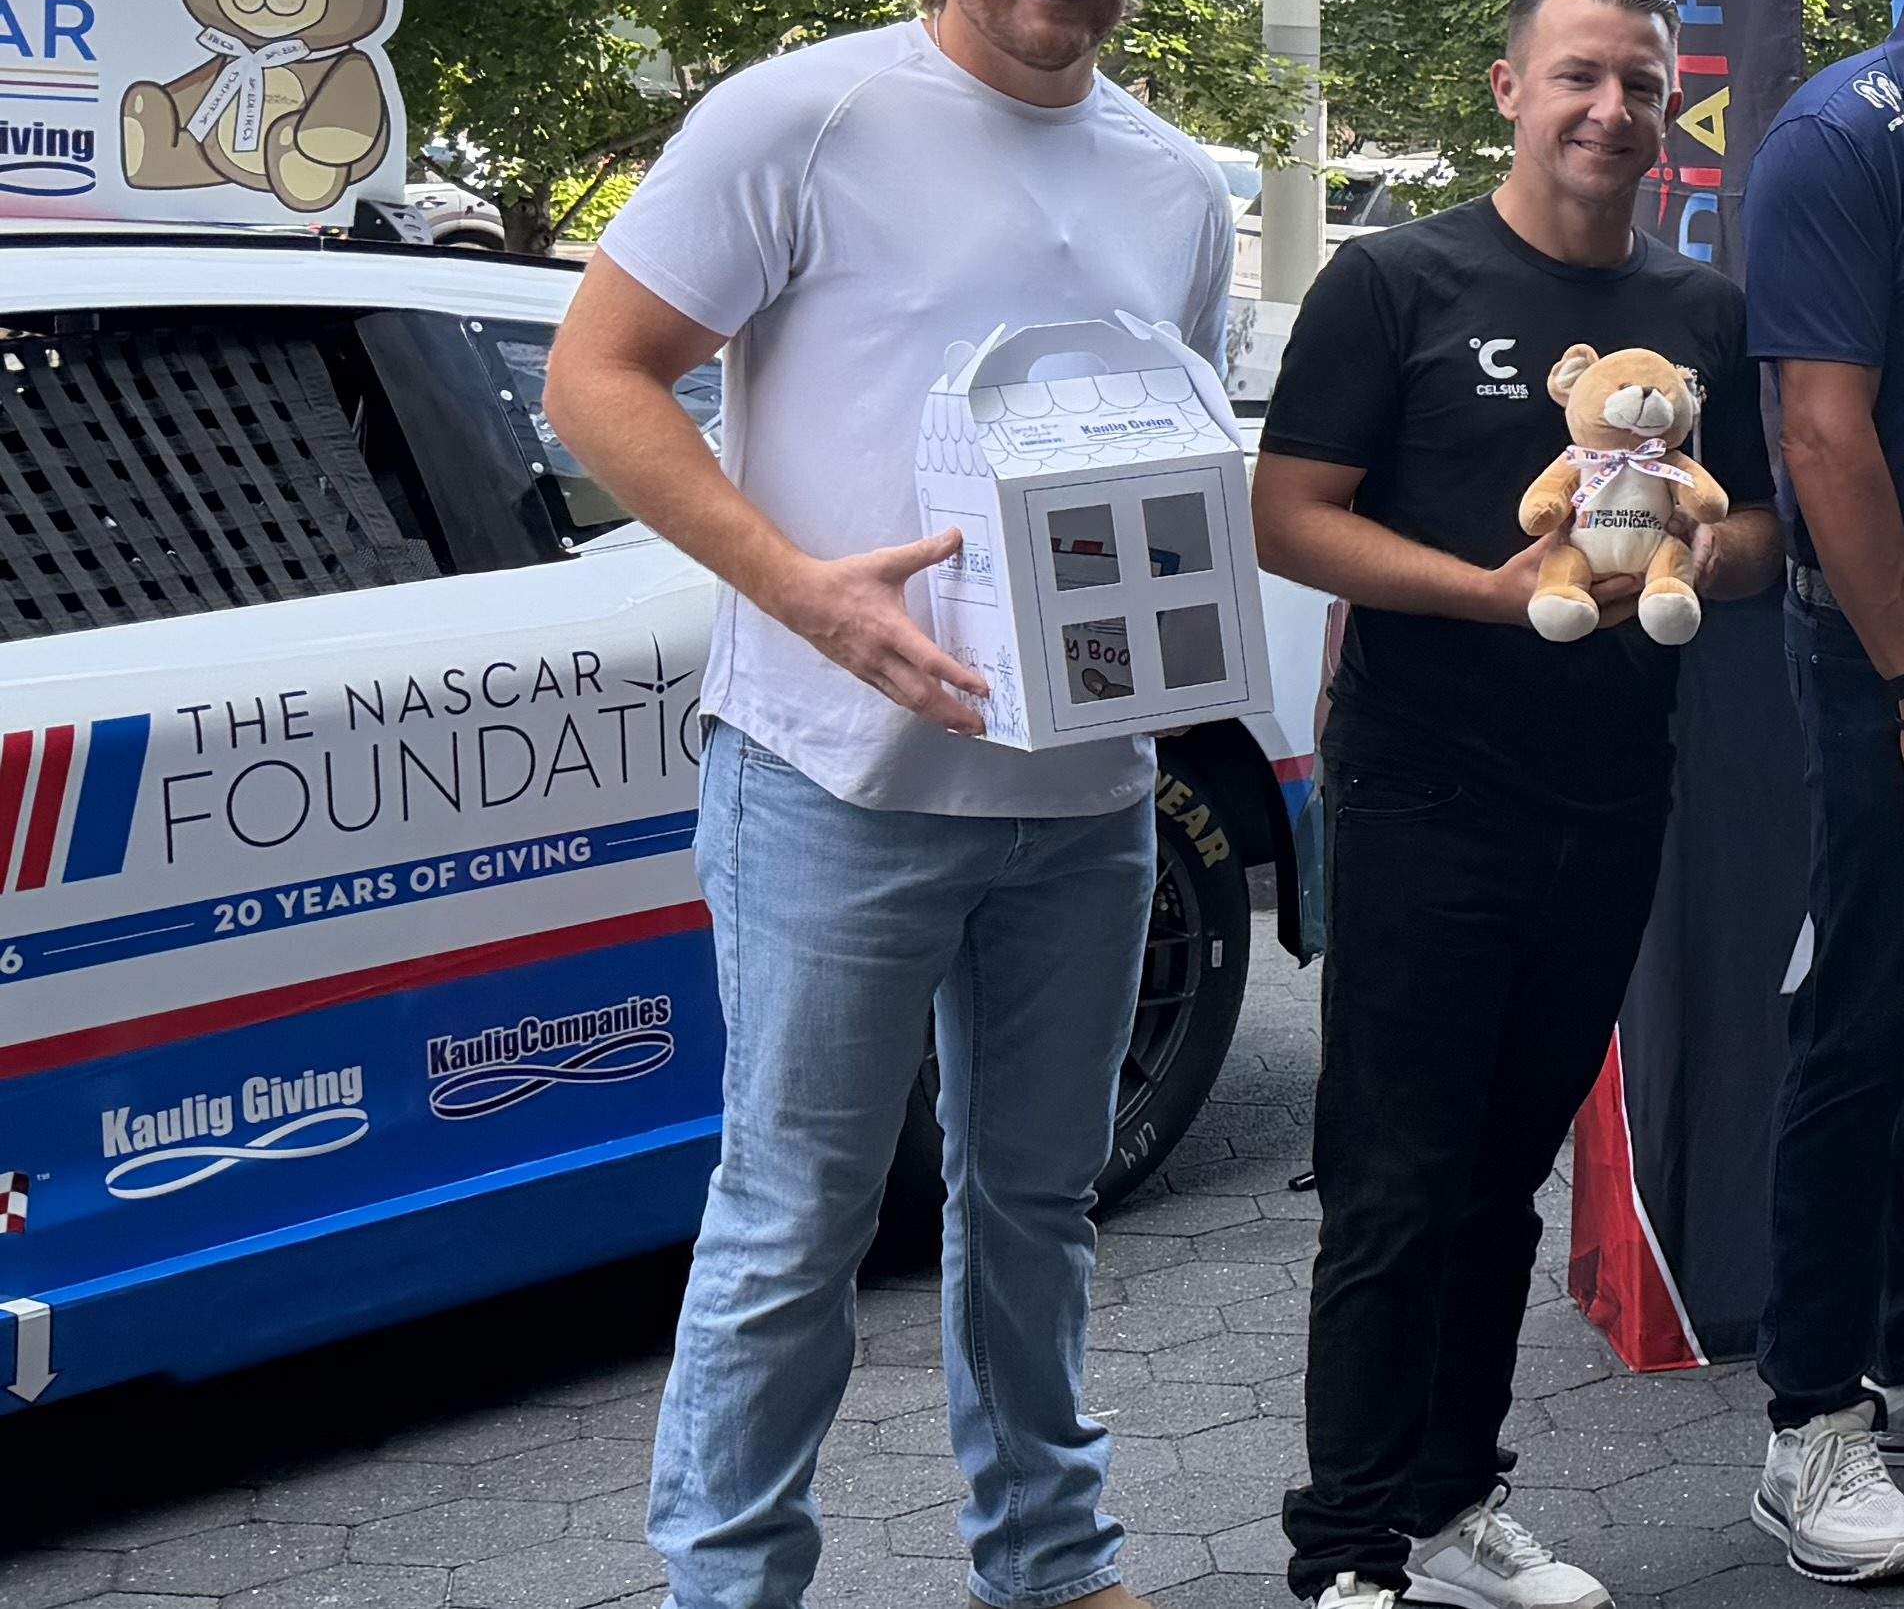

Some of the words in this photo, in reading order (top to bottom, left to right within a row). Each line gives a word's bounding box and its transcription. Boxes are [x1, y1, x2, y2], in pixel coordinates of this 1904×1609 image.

[0, 120, 95, 163] iving
[1476, 384, 1529, 396] CELSIUS
[177, 690, 314, 755] THE
[345, 649, 604, 731] NASCAR
[162, 700, 702, 865] FOUNDATI
[212, 900, 260, 935] 20
[274, 873, 397, 922] YEARS
[410, 861, 457, 895] OF
[469, 835, 593, 884] GIVING
[428, 995, 671, 1075] KauligCompanies
[101, 1088, 233, 1161] Kaulig
[242, 1063, 364, 1126] Giving
